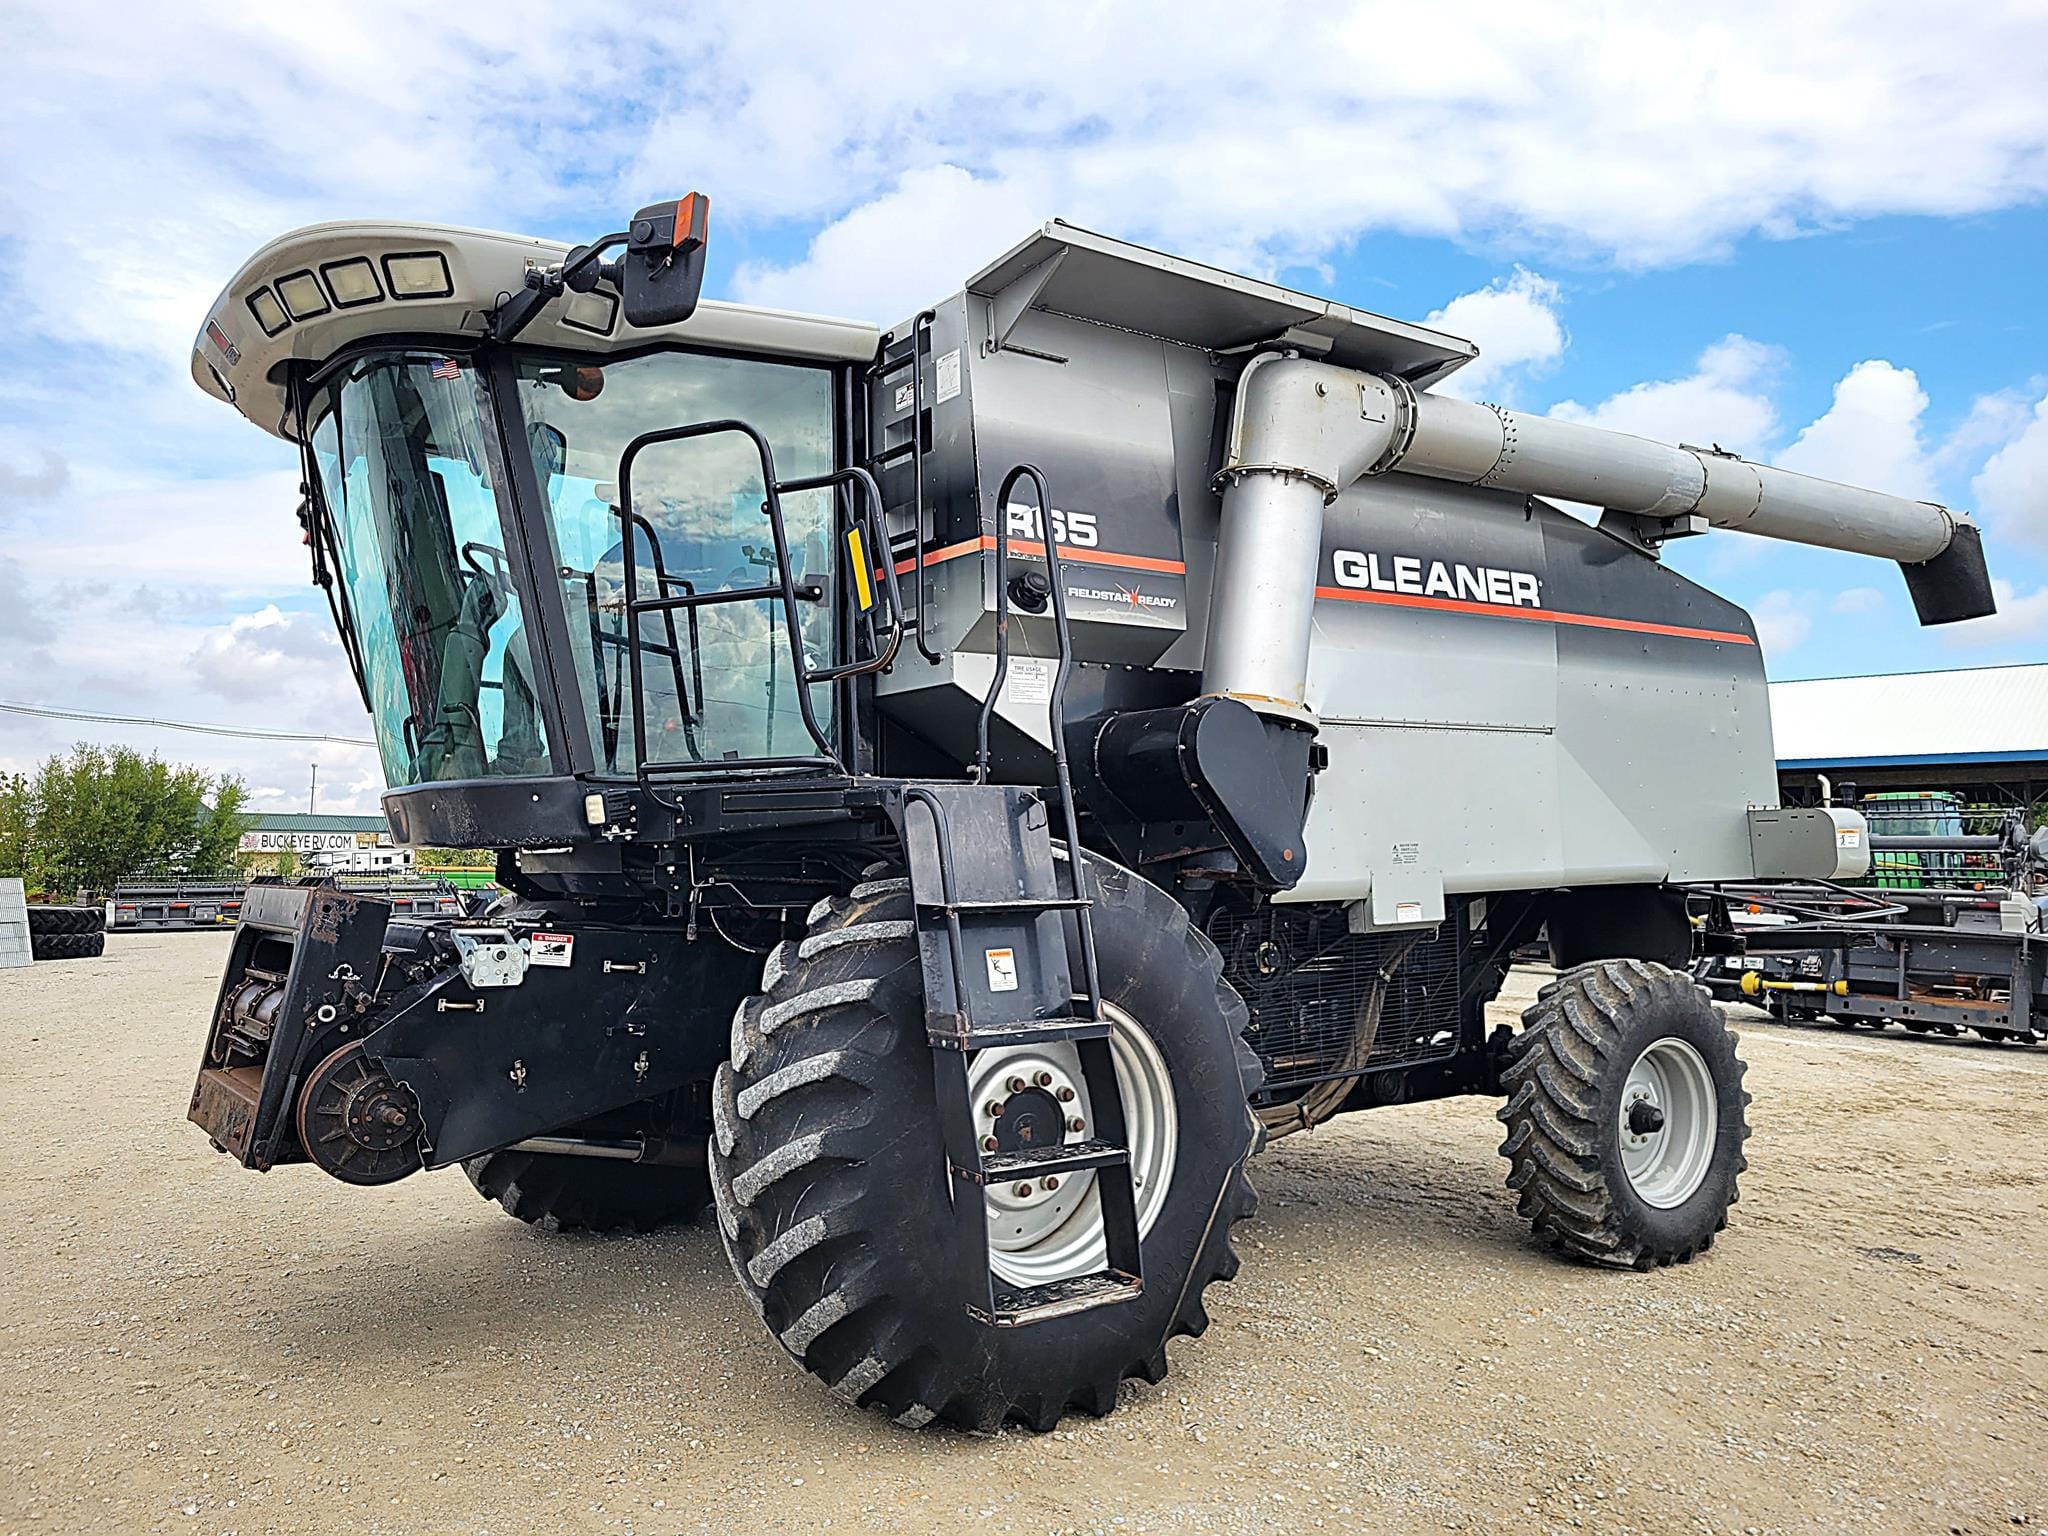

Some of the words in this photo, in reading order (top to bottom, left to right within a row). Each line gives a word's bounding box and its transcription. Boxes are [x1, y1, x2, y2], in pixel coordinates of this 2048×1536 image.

[1007, 502, 1098, 547] R65
[1068, 587, 1131, 603] FIELDSTAR
[1137, 594, 1177, 608] READY
[1333, 550, 1541, 608] GLEANER
